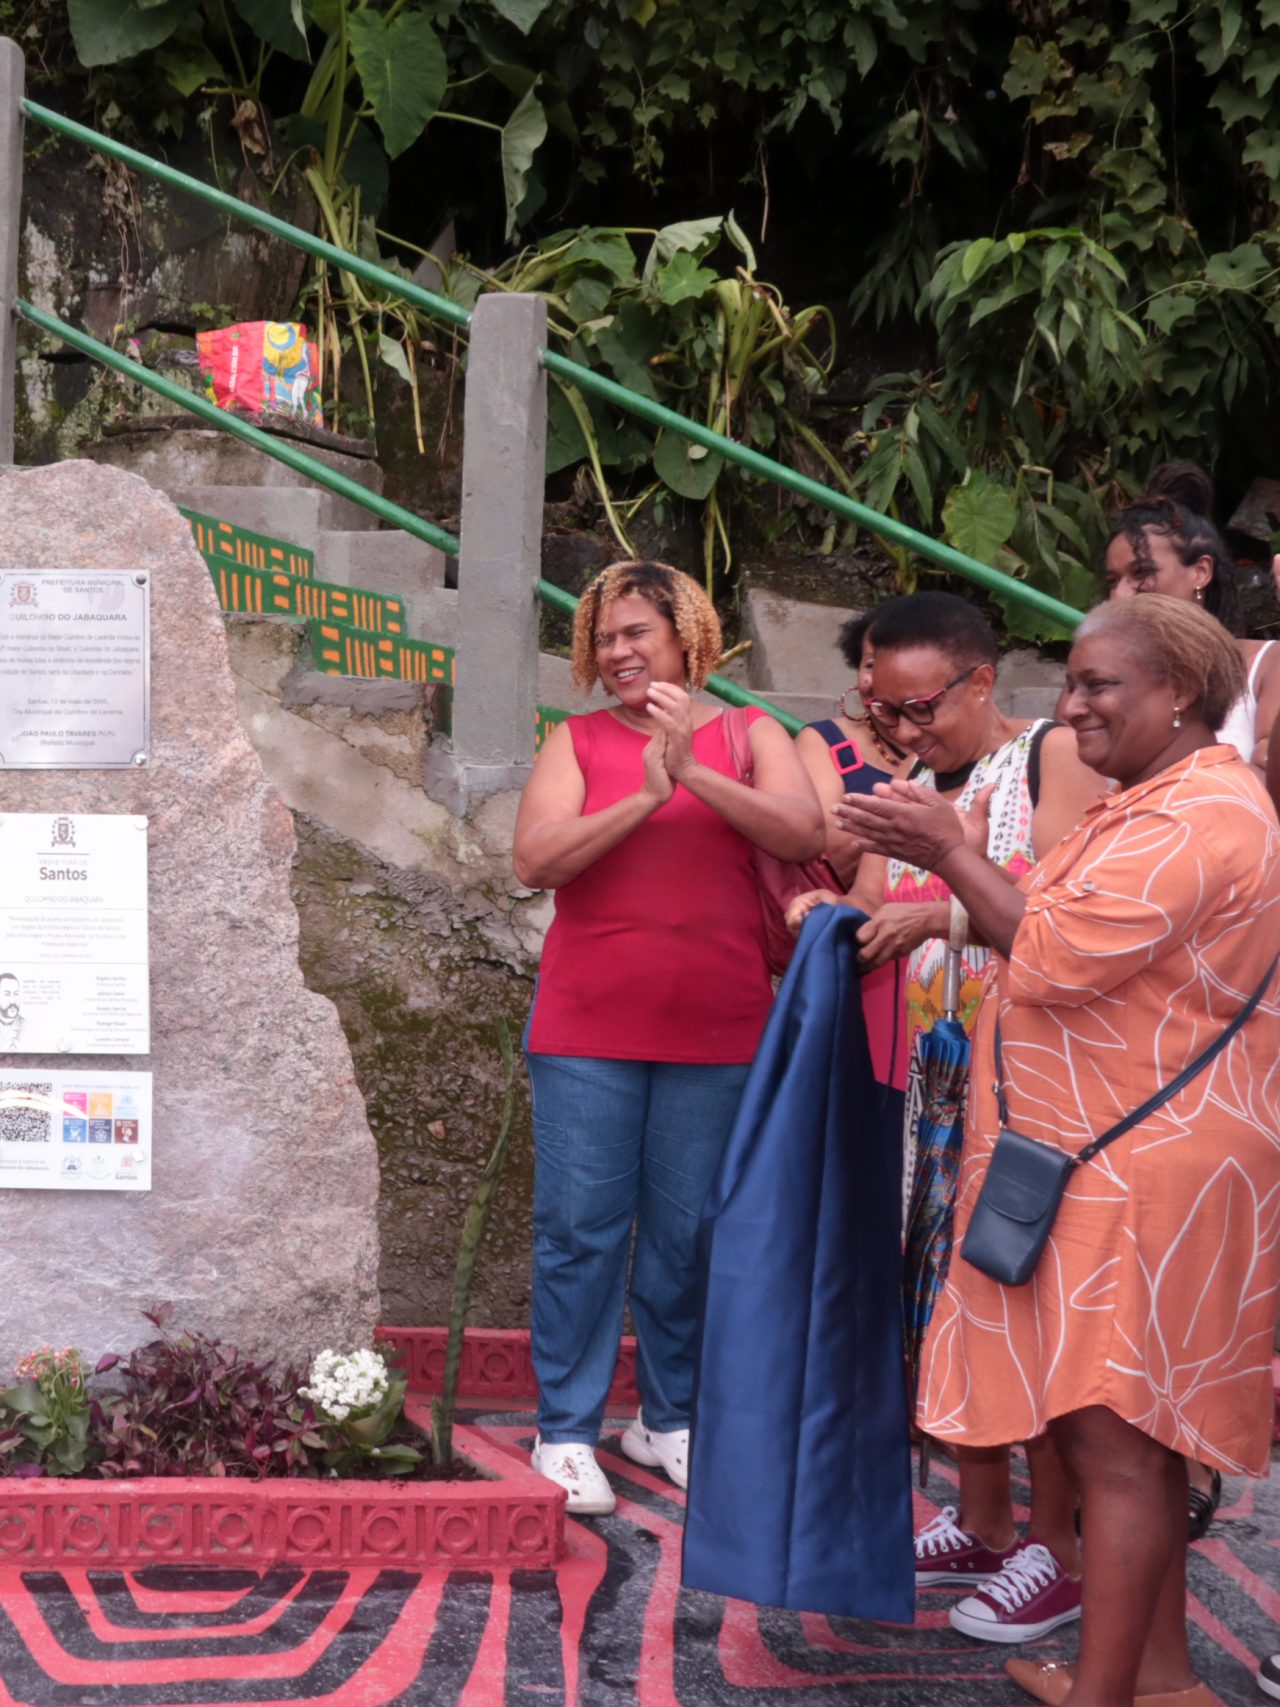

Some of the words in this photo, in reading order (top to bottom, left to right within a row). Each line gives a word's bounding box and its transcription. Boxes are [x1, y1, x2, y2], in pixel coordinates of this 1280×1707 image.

[57, 613, 71, 621] DO
[72, 613, 127, 621] JABAQUARA
[39, 866, 88, 881] Santos
